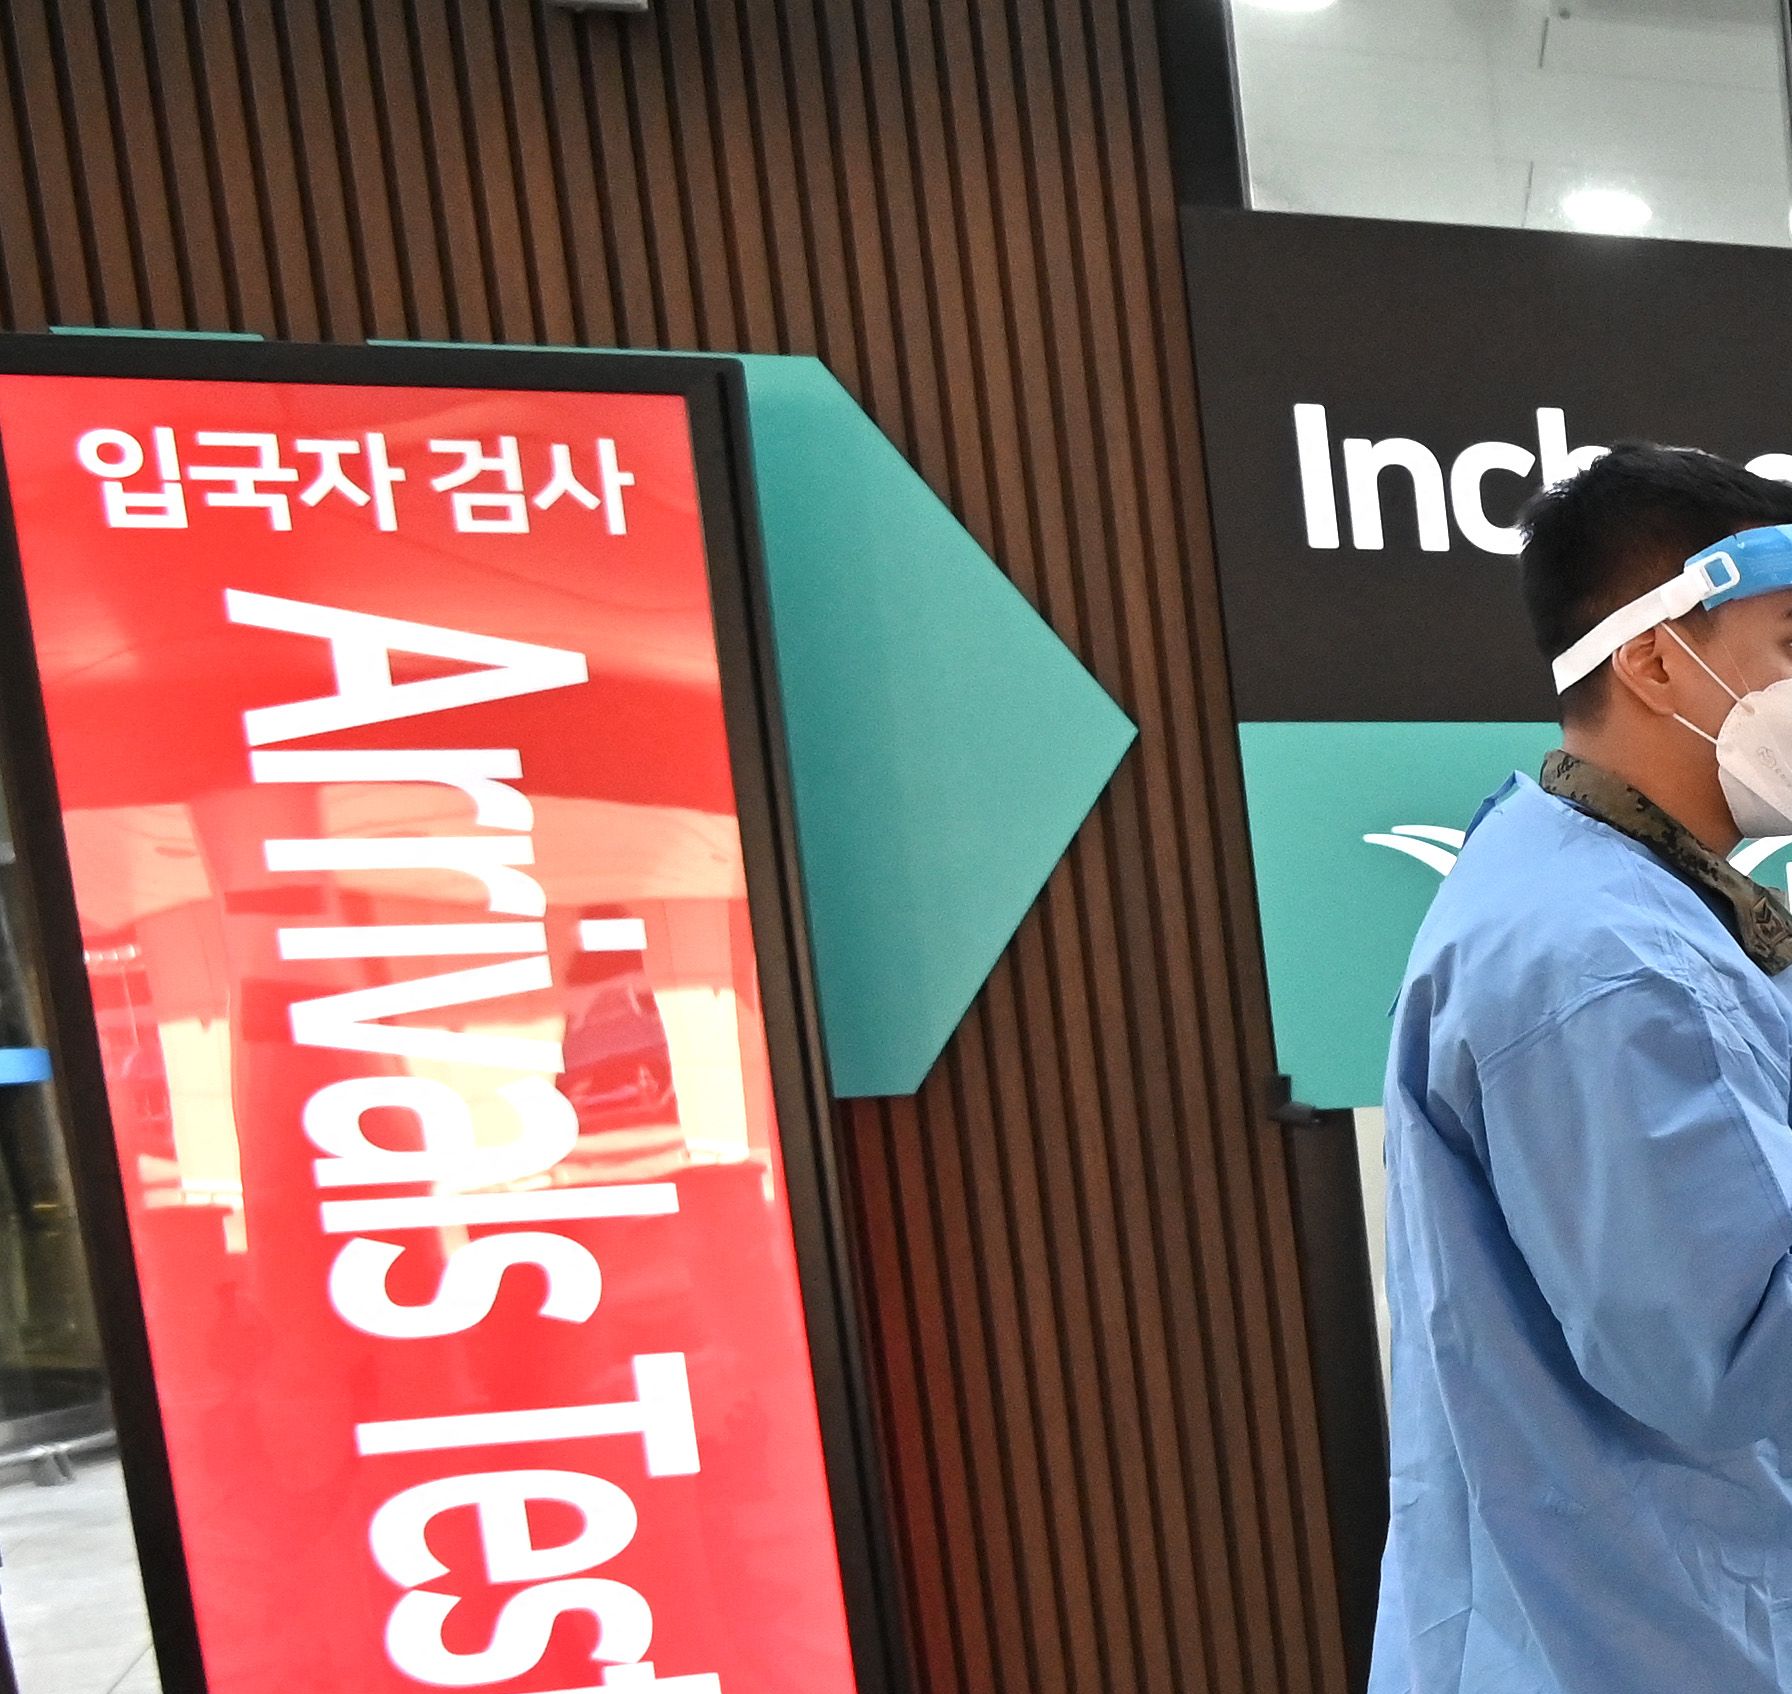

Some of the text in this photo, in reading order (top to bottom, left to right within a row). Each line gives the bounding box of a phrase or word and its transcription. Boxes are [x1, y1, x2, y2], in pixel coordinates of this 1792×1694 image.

[76, 426, 636, 537] 입국자 검사
[224, 588, 679, 1340] Arrivals
